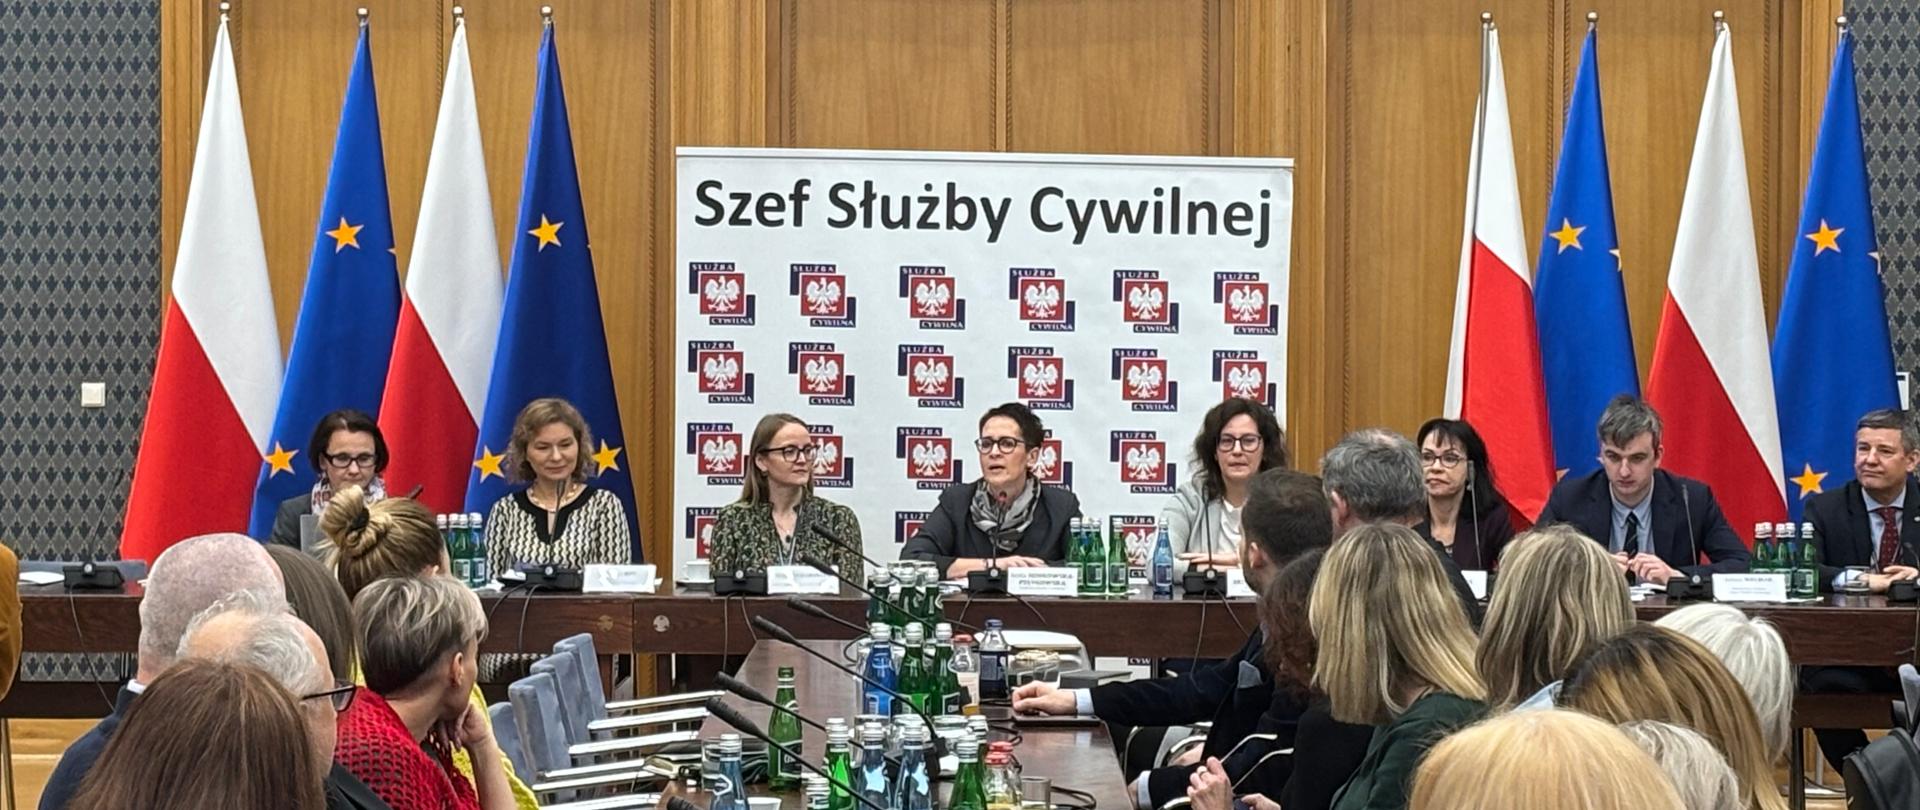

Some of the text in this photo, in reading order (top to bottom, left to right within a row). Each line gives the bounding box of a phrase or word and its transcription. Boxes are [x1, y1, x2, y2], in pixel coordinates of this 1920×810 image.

[695, 179, 1270, 248] Szef Służby Cywilnej
[691, 263, 733, 271] SŁUŻBA
[792, 265, 834, 273] SŁUŻBA
[901, 267, 943, 275] SŁUŻBA
[1011, 269, 1053, 277] SŁUŻBA
[1115, 271, 1157, 279] SŁUŻBA
[1216, 273, 1258, 281] SŁUŻBA
[711, 317, 754, 325] CYWILNA
[812, 319, 855, 327] CYWILNA
[921, 321, 964, 329] CYWILNA
[1031, 323, 1074, 331] CYWILNA
[1135, 325, 1178, 333] CYWILNA
[1235, 327, 1278, 335] CYWILNA
[690, 341, 732, 349] SŁUŻBA
[791, 343, 833, 351] SŁUŻBA
[900, 345, 942, 353] SŁUŻBA
[1010, 347, 1052, 355] SŁUŻBA
[1114, 349, 1156, 357] SŁUŻBA
[1214, 351, 1256, 359] SŁUŻBA
[710, 395, 753, 403] CYWILNA
[810, 397, 853, 405] CYWILNA
[920, 400, 963, 408] CYWILNA
[1030, 402, 1073, 410] CYWILNA
[1133, 403, 1176, 411] CYWILNA
[689, 424, 731, 432] SŁUŻBA
[1132, 484, 1175, 492] CYWILNA
[1124, 516, 1153, 524] UŻBA
